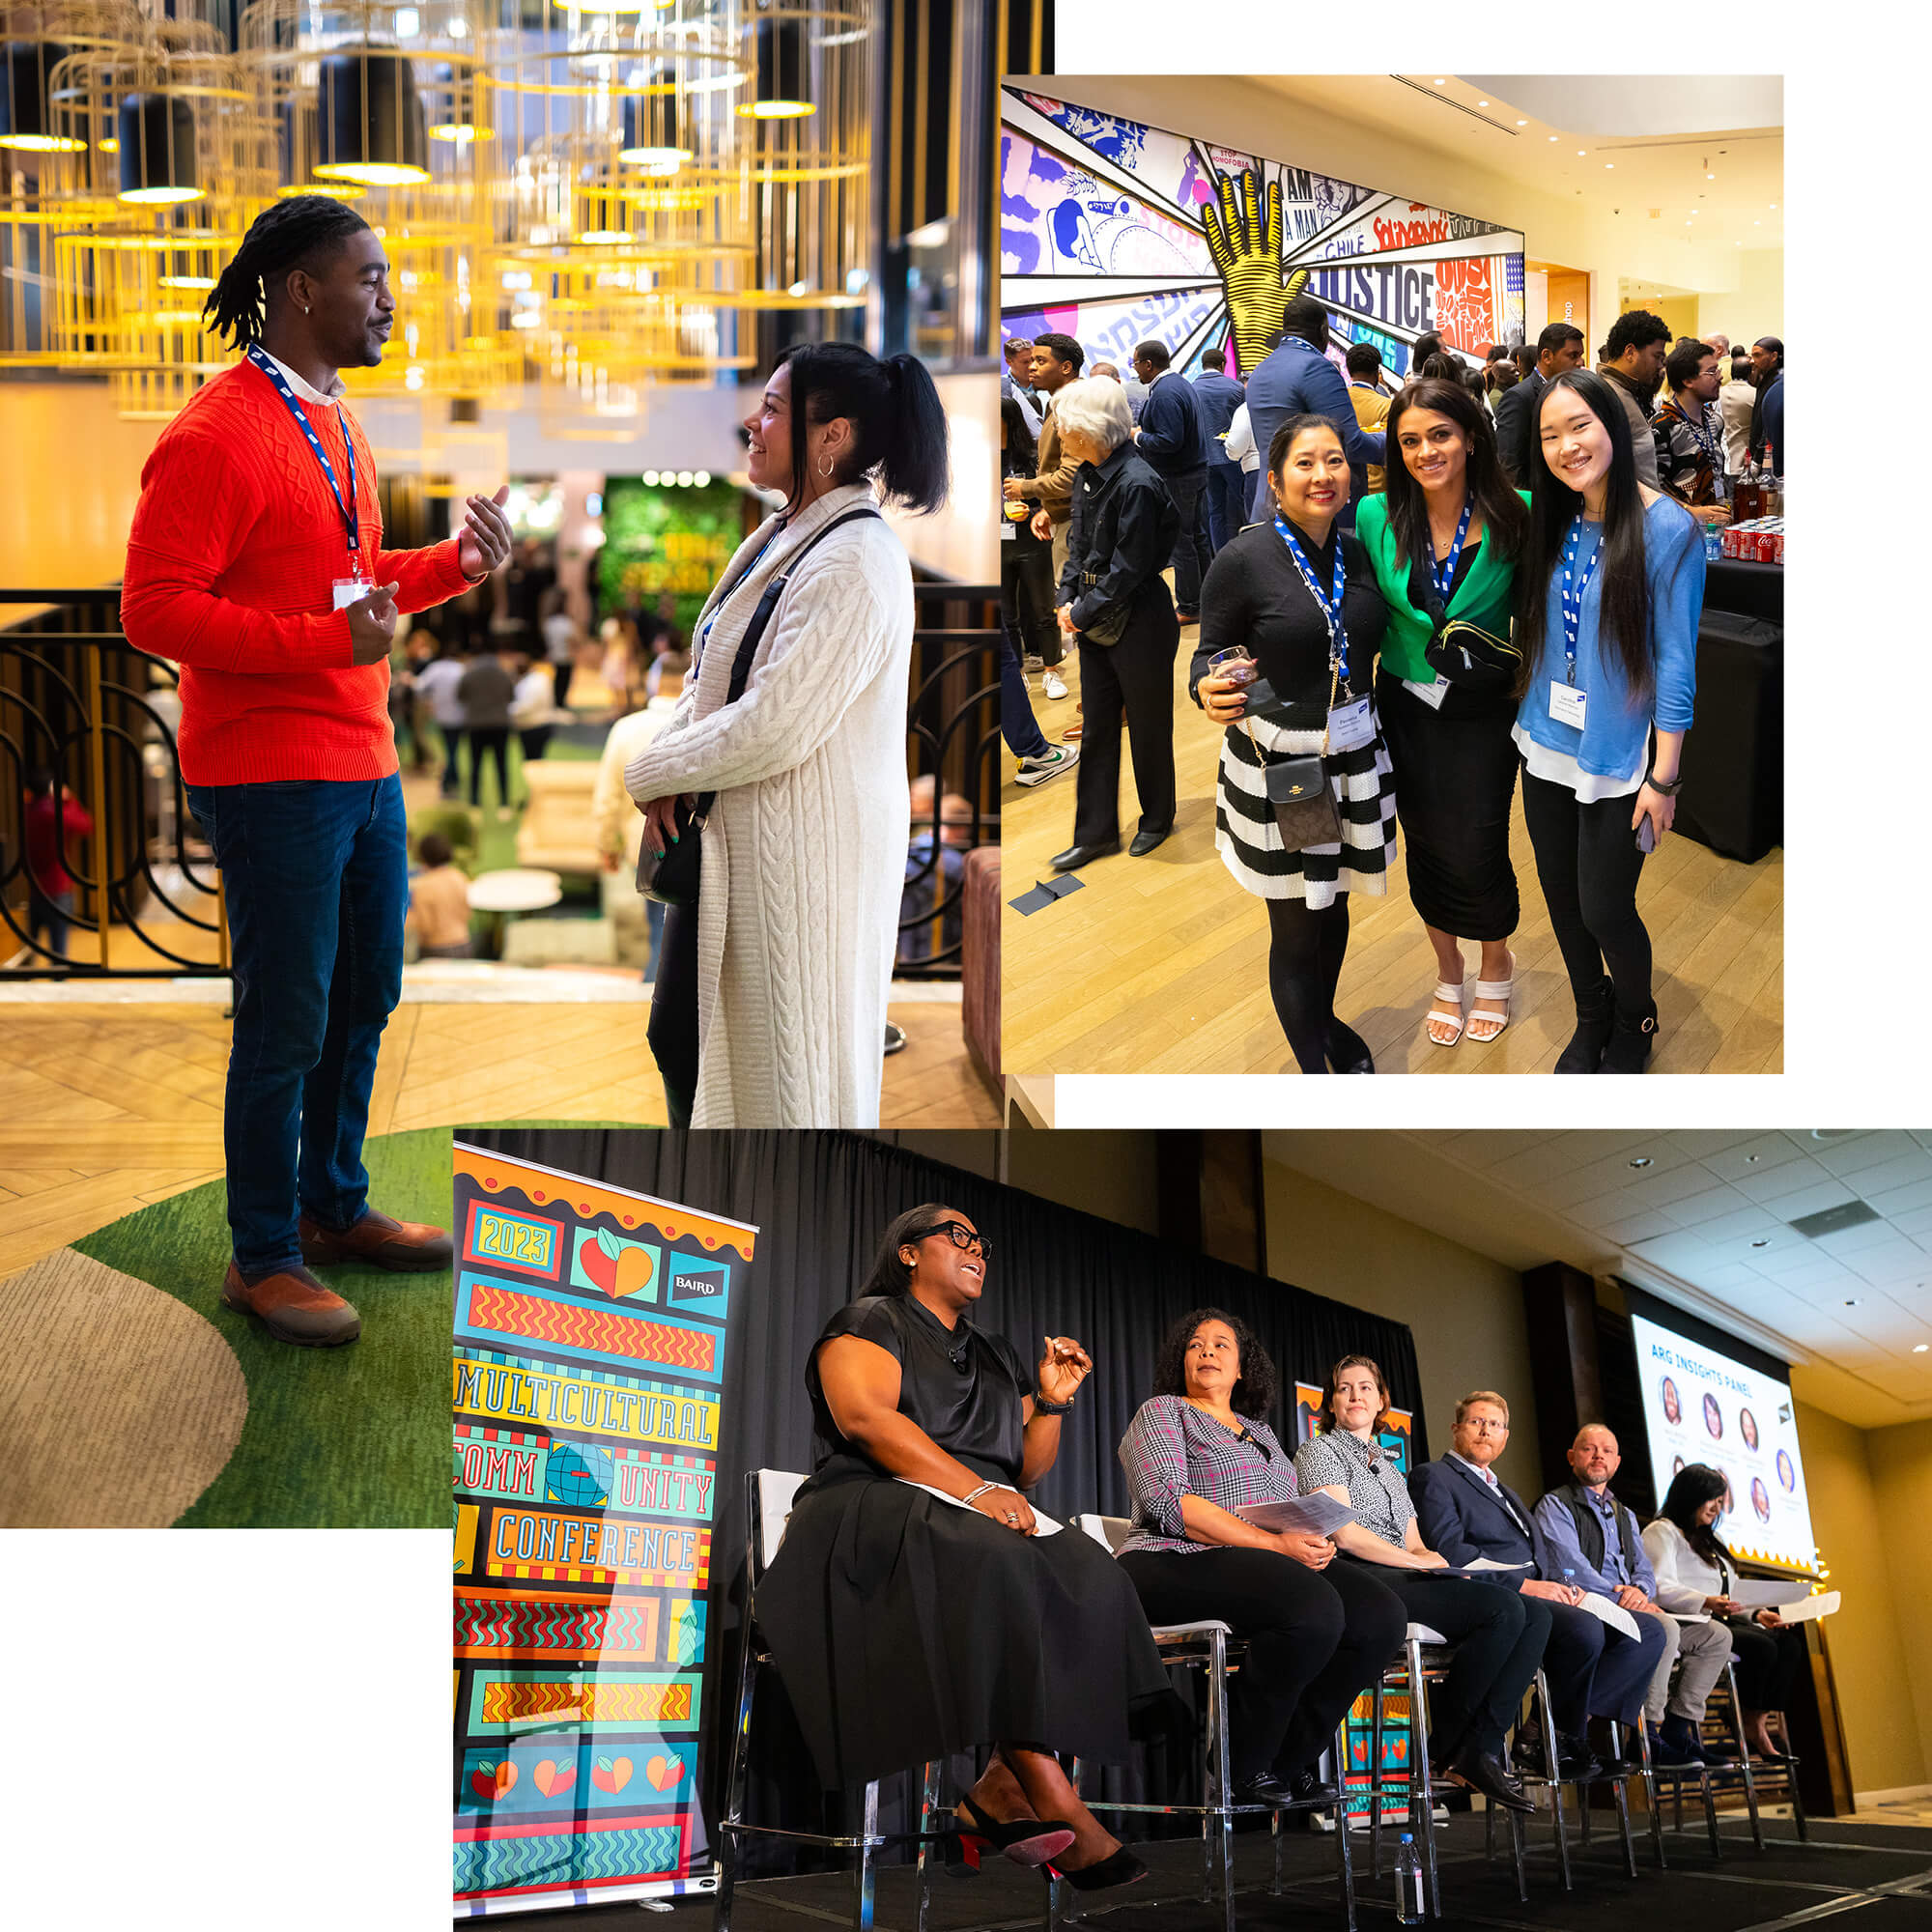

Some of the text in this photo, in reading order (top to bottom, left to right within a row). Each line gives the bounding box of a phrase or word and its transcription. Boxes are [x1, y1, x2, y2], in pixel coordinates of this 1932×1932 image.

[1211, 156, 1250, 168] HOMOFOBIA
[1220, 150, 1237, 158] STOP
[1287, 168, 1313, 200] AM
[1285, 209, 1318, 241] A MAN
[1325, 235, 1365, 260] CHILE
[1308, 262, 1434, 331] JUSTICE
[484, 1217, 547, 1263] 2023
[675, 1276, 715, 1295] BAIRD
[1652, 1344, 1753, 1399] ARG INSIGHTS PANEL
[454, 1363, 713, 1445] MULTICULTURAL
[619, 1464, 713, 1515] UNITY
[496, 1513, 696, 1572] CONFERENCE
